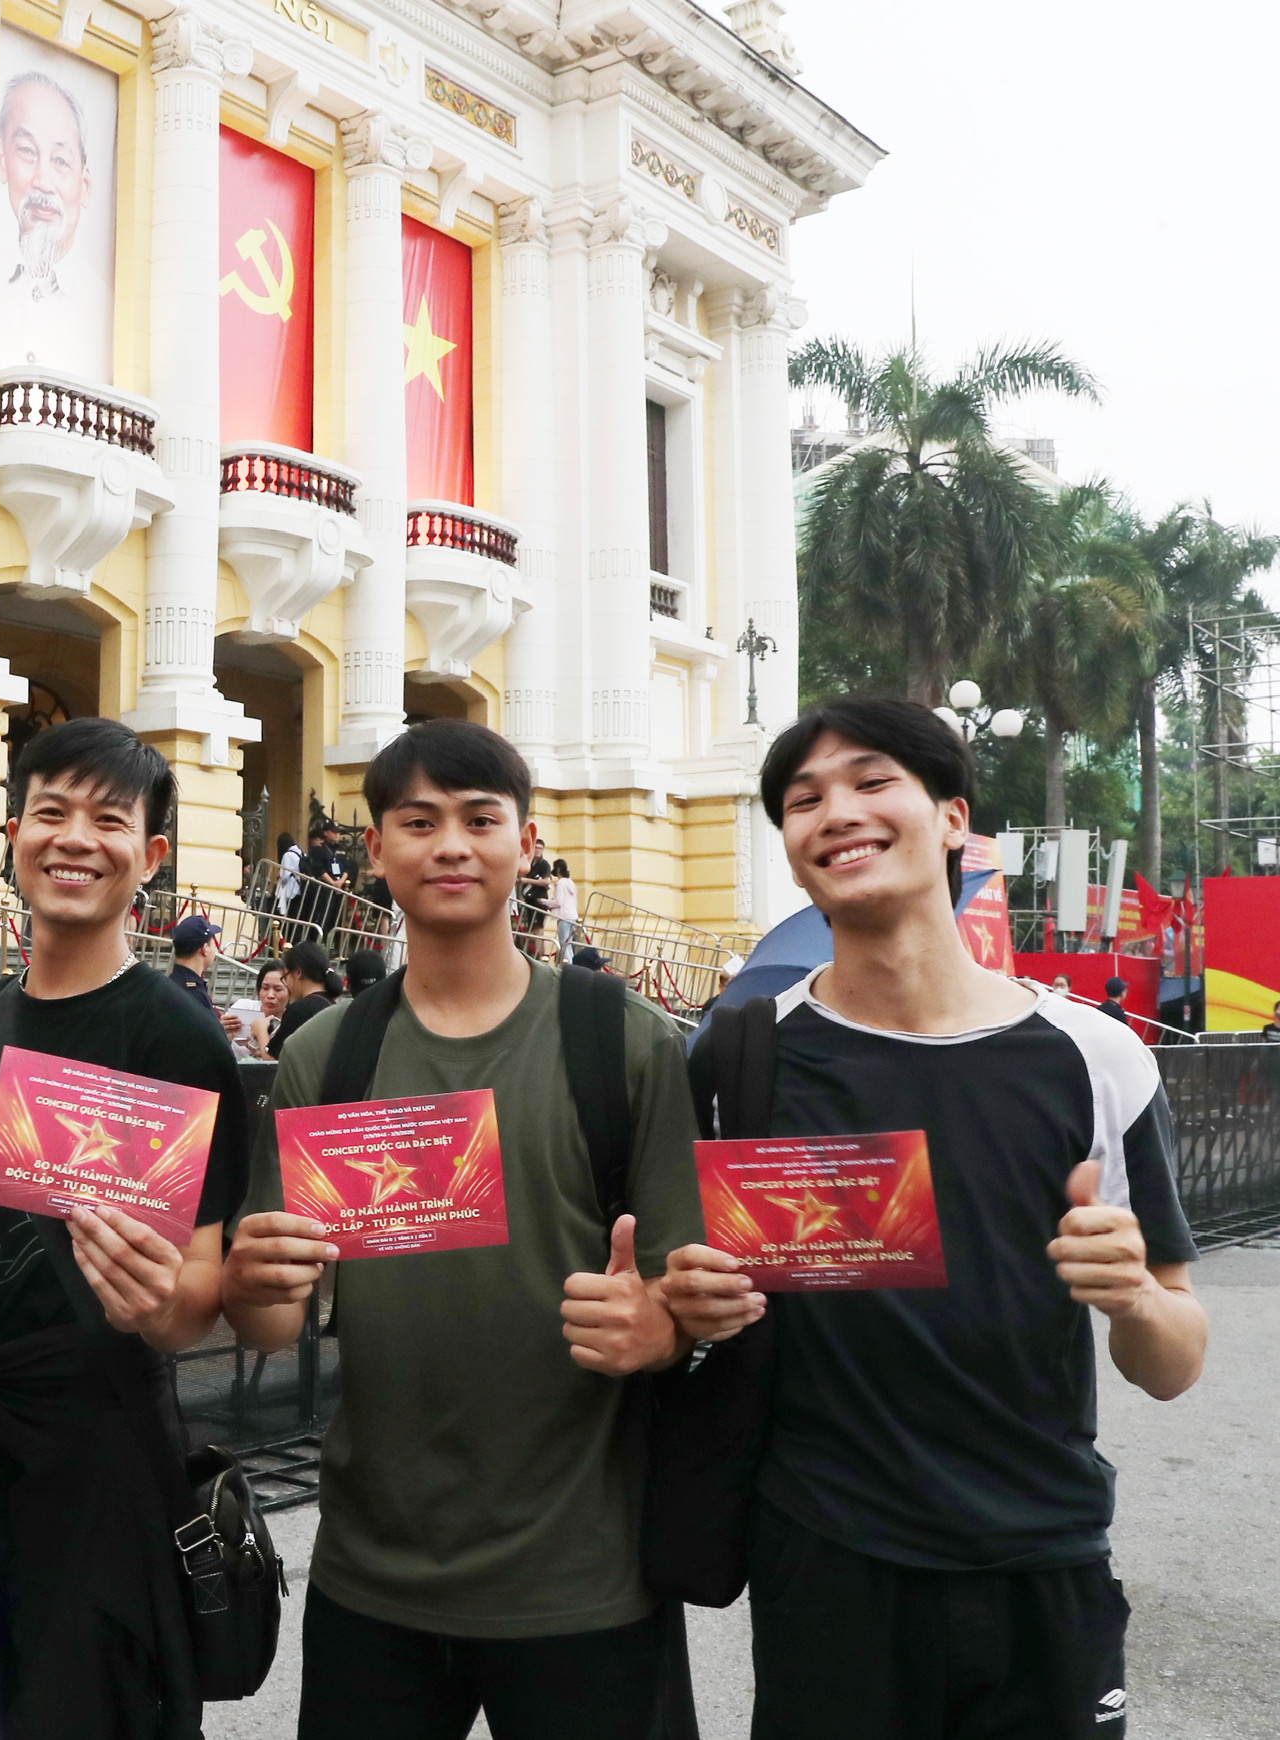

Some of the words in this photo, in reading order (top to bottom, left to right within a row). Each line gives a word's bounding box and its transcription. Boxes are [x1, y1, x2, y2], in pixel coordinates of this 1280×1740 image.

[35, 1095, 78, 1112] CONCERT
[78, 1102, 107, 1119] QUỐC
[107, 1111, 124, 1122] GIA
[124, 1113, 145, 1129] ĐẶC
[145, 1118, 166, 1133] BIỆT
[321, 1144, 364, 1157] CONCERT
[365, 1139, 393, 1153] QUỐC
[394, 1140, 411, 1149] GIA
[411, 1136, 432, 1149] ĐẶC
[432, 1134, 453, 1147] BIỆT
[4, 1164, 32, 1183] ĐỘC
[31, 1170, 55, 1188] LẬP
[61, 1179, 78, 1193] TỰ
[79, 1183, 97, 1195] DO
[103, 1188, 137, 1206] HẠNH
[138, 1193, 171, 1211] PHÚC
[33, 1158, 51, 1170] 80
[51, 1160, 78, 1176] NĂM
[79, 1166, 113, 1184] HÀNH
[114, 1174, 148, 1192] TRÌNH
[339, 1207, 356, 1217] 80
[357, 1202, 383, 1216] NĂM
[385, 1198, 418, 1213] HÀNH
[420, 1195, 453, 1209] TRÌNH
[342, 1218, 364, 1233] LẬP
[372, 1217, 388, 1230] TỰ
[389, 1216, 406, 1226] DO
[414, 1211, 447, 1225] HẠNH
[448, 1206, 480, 1220] PHÚC
